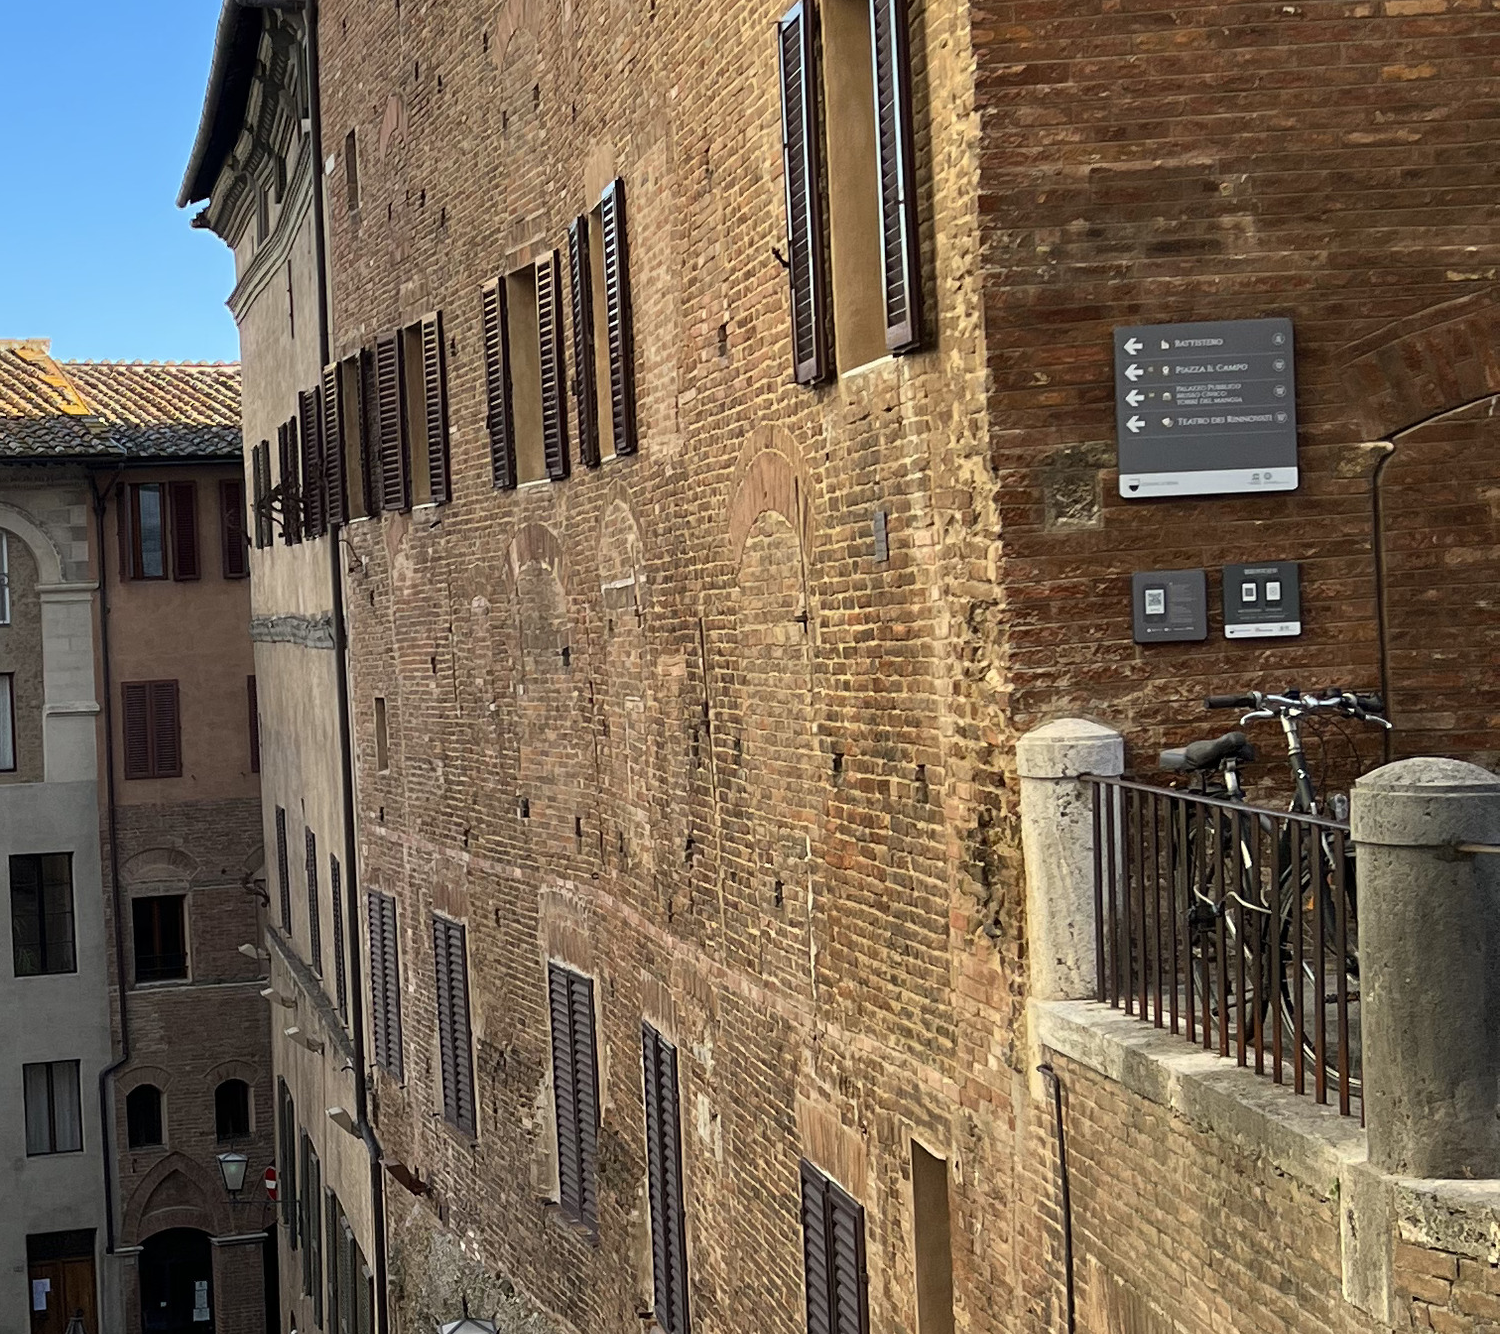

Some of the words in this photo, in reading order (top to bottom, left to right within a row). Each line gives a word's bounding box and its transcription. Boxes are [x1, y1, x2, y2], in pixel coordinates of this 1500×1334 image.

[1174, 338, 1224, 348] BATTISTERO
[1175, 365, 1206, 374] PIAZZA
[1207, 364, 1214, 372] IL
[1215, 363, 1249, 372] CAMPO
[1207, 383, 1242, 391] PUBBLICO
[1177, 398, 1198, 406] TORRE
[1177, 417, 1210, 426] TEATRO
[1210, 416, 1225, 424] DEI
[1226, 414, 1273, 423] RINNOVATI
